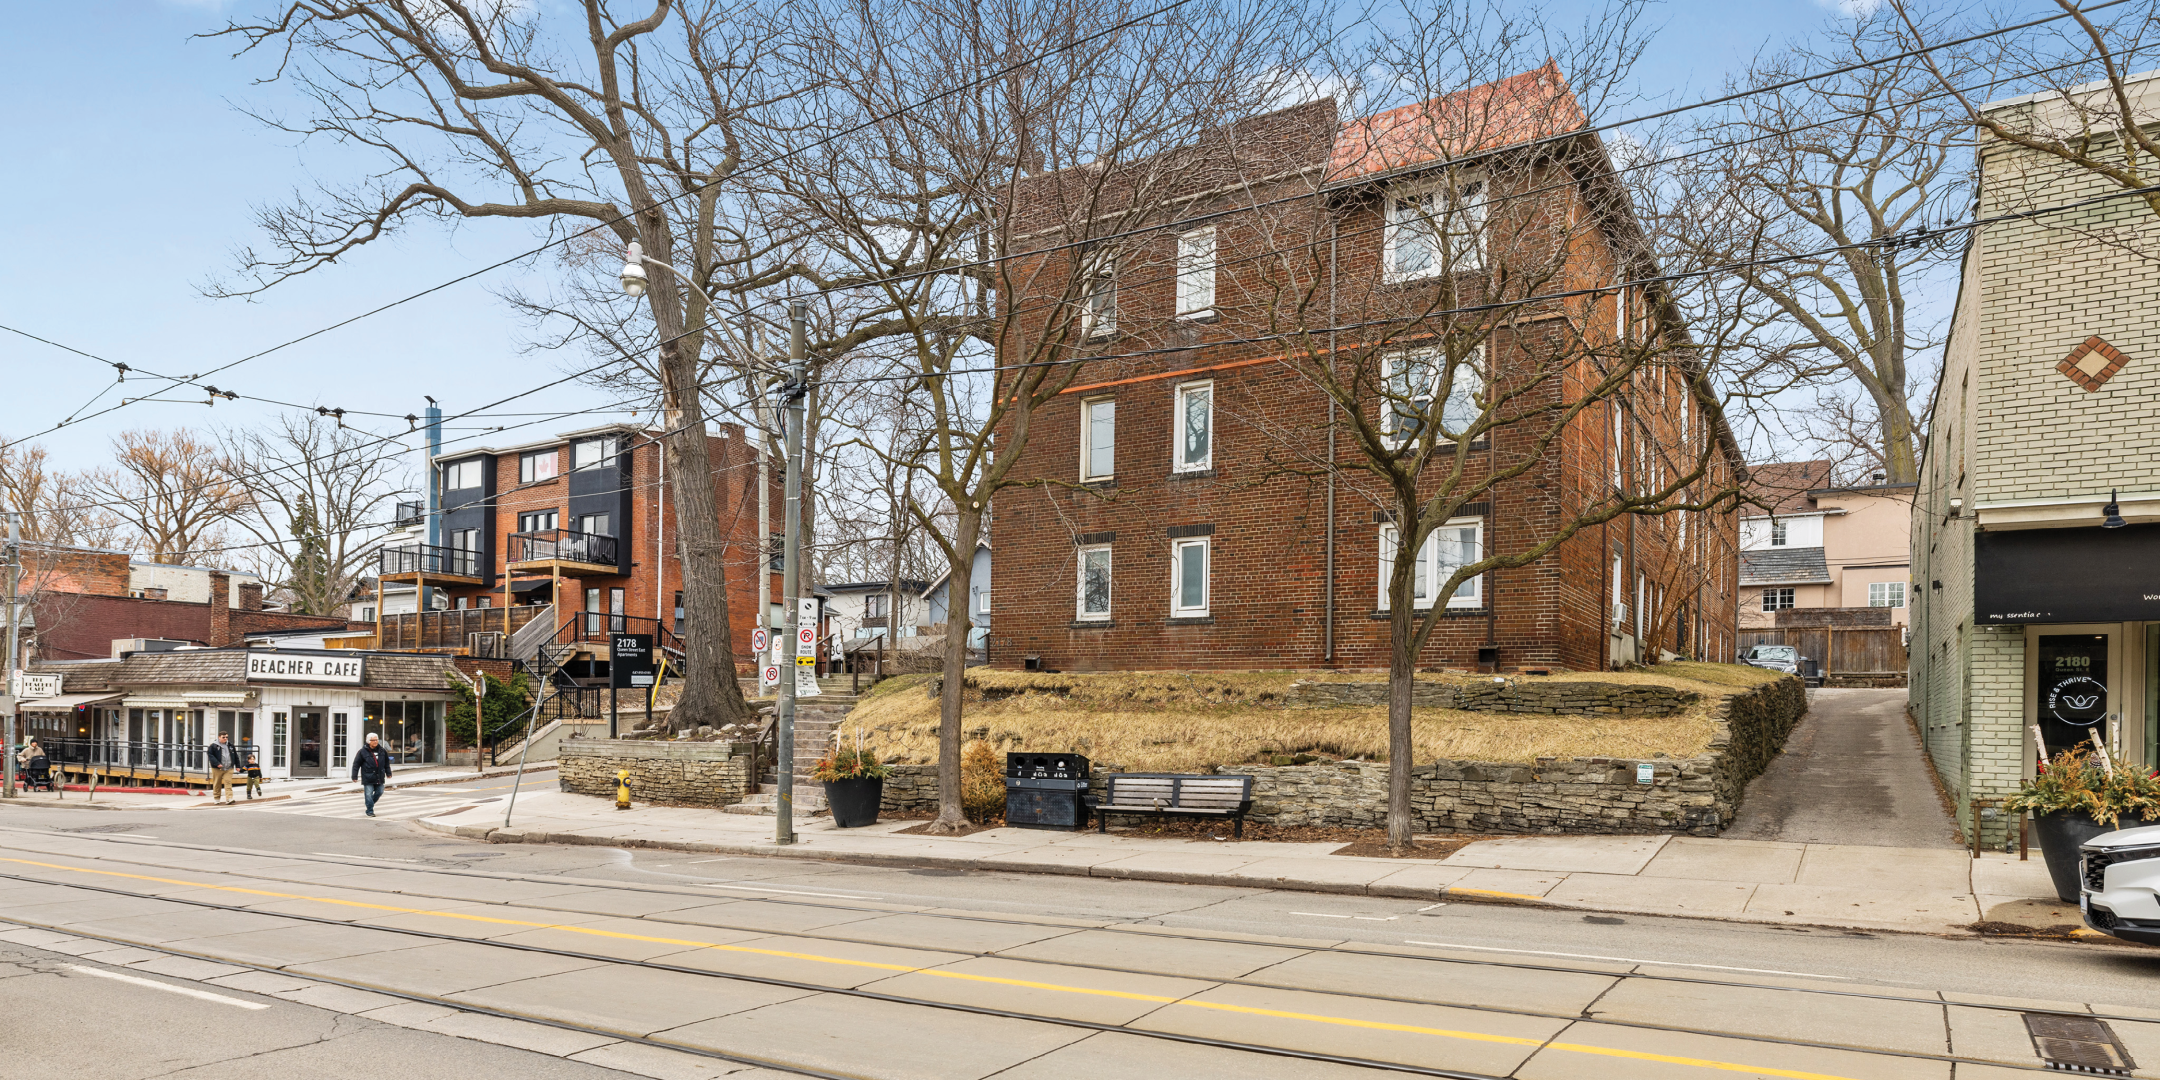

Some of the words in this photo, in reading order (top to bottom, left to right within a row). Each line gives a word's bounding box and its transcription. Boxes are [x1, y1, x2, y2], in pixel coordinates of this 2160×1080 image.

[617, 638, 637, 648] 2178
[251, 659, 313, 675] BEACHER
[324, 662, 358, 676] CAFE
[2055, 656, 2091, 667] 2180
[2049, 693, 2058, 709] RISE
